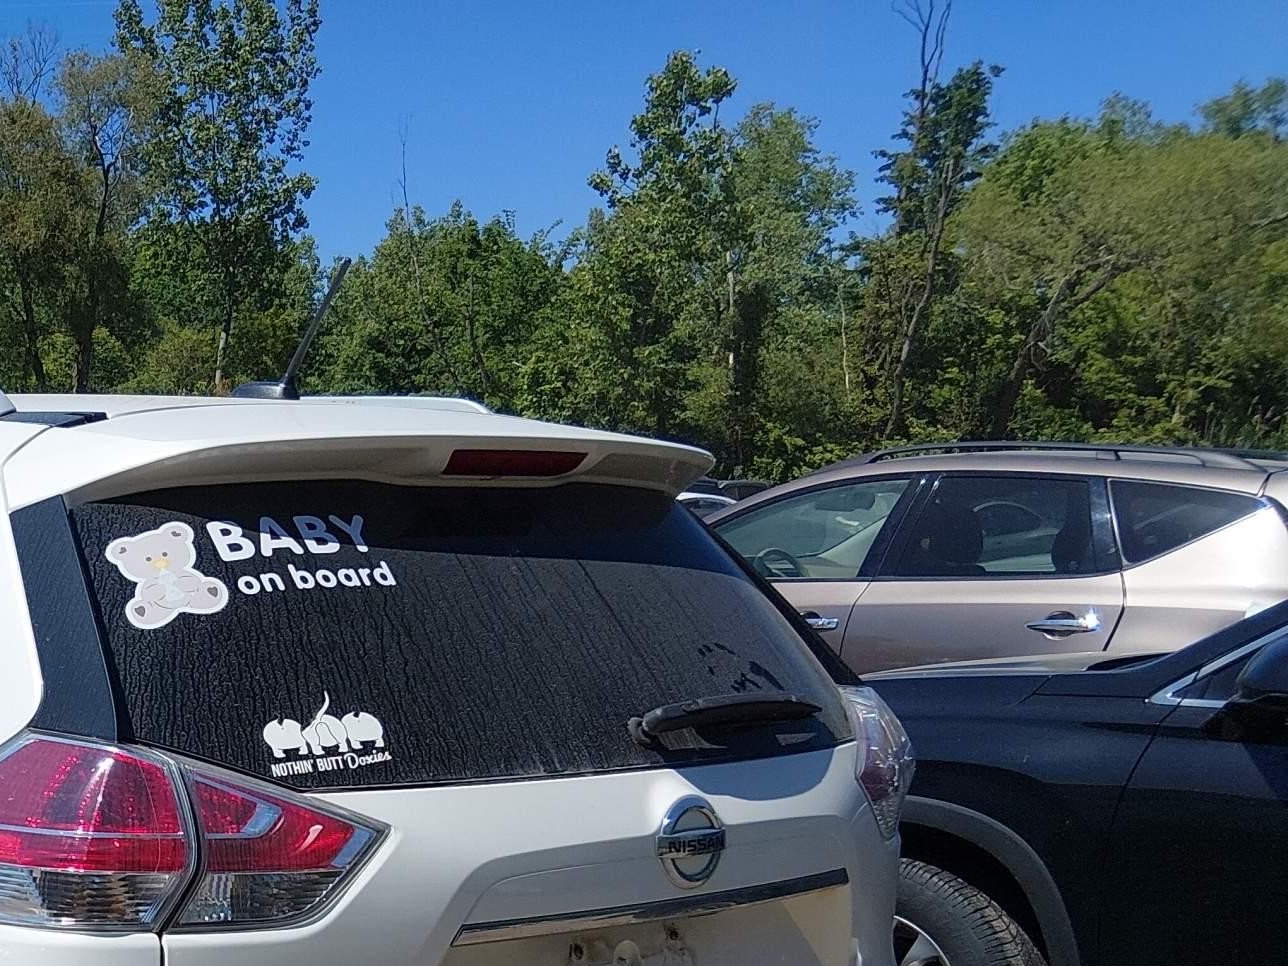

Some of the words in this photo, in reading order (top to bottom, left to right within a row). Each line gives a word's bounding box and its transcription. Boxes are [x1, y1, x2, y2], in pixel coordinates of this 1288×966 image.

[206, 514, 369, 562] BABY
[237, 564, 286, 595] on
[287, 561, 397, 590] board
[271, 759, 314, 778] NOTHIN'
[316, 756, 344, 772] BUTT
[343, 749, 392, 769] Doxies
[668, 834, 725, 854] NISSAN
